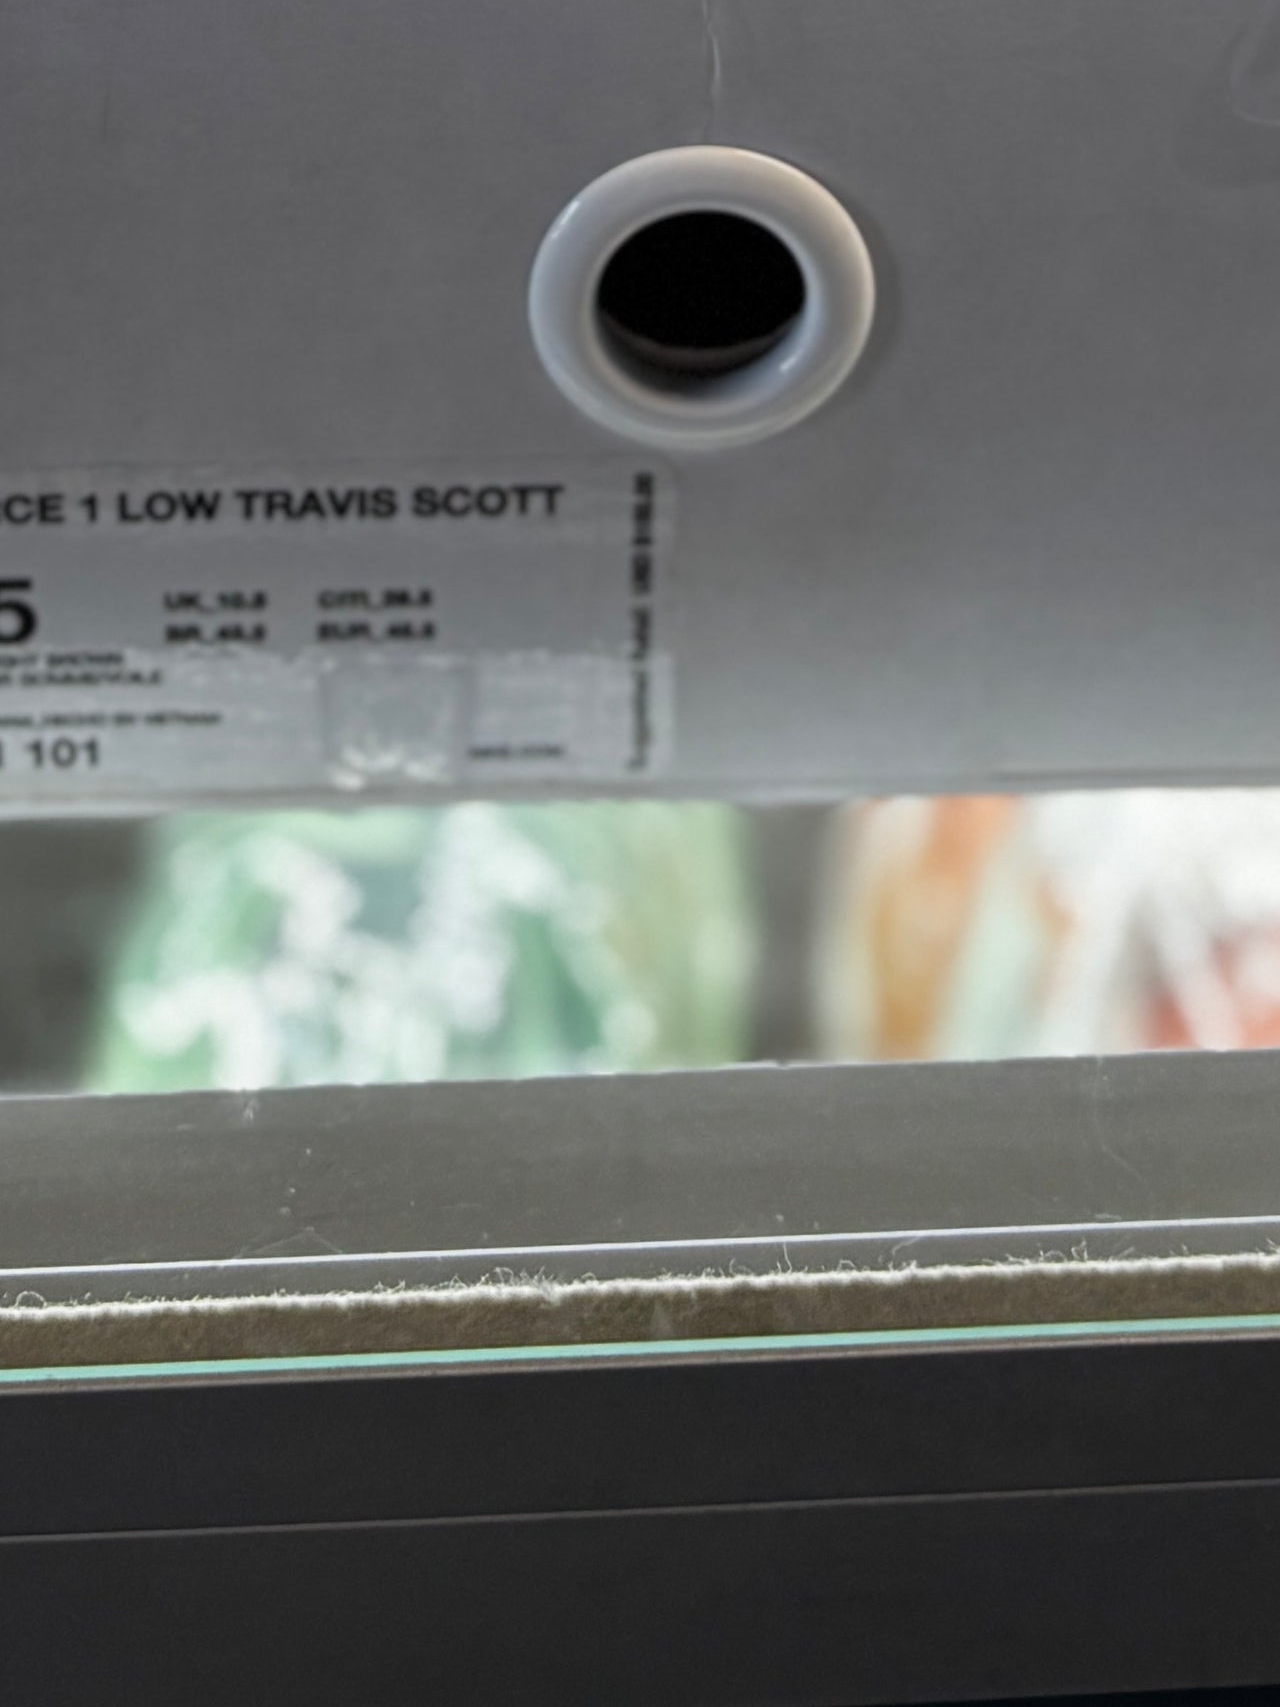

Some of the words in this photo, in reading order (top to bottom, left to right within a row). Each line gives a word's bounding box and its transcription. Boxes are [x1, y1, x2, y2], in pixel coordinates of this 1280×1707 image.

[80, 493, 98, 524] 1
[118, 489, 220, 523] LOW
[235, 488, 398, 521] TRAVIS
[412, 484, 564, 519] SCOTT
[27, 738, 99, 769] 101
